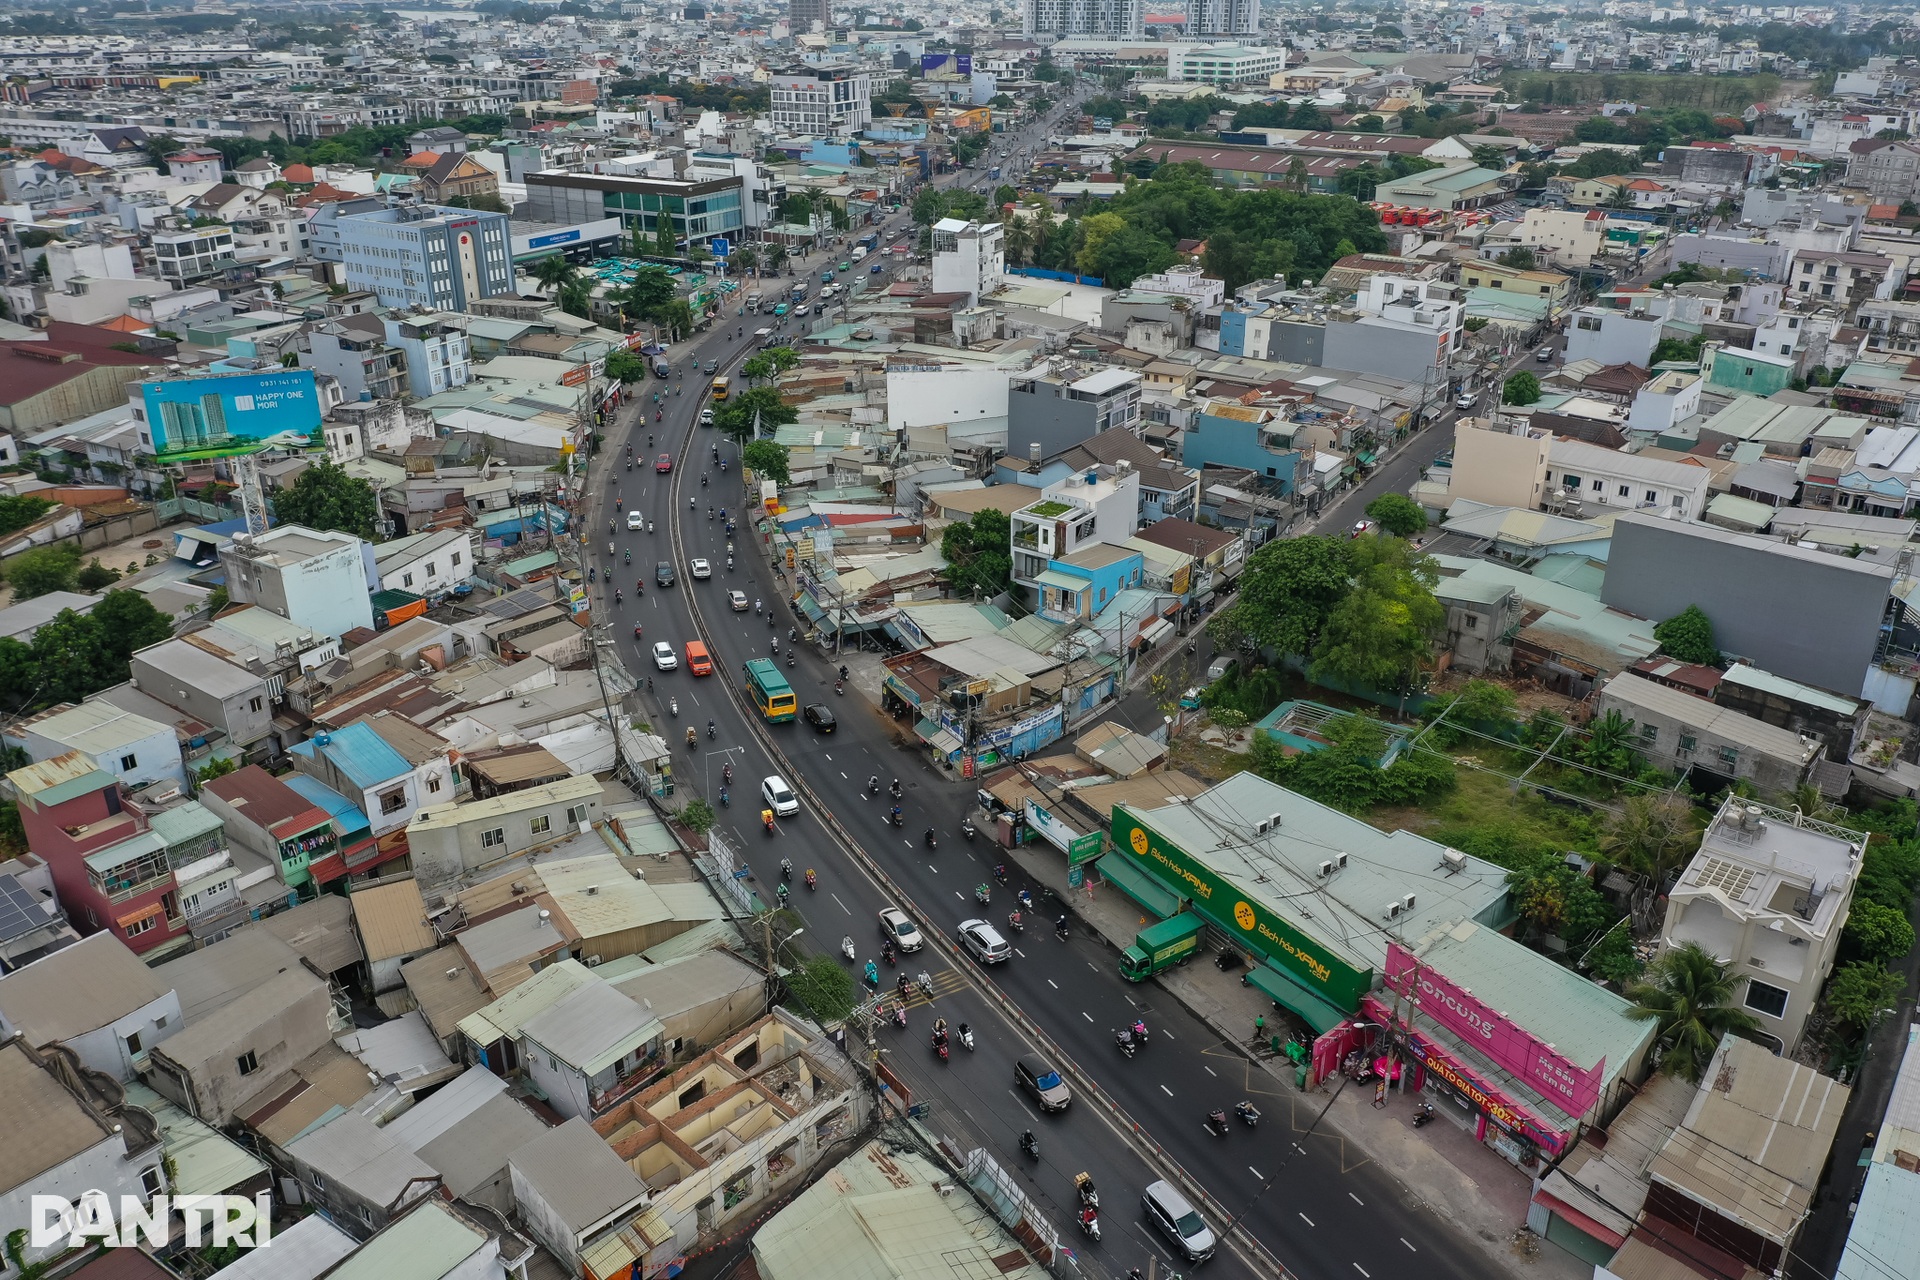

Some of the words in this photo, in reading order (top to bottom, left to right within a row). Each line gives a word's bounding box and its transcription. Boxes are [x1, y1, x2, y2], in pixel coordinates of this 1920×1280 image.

[255, 392, 284, 401] HAPPY
[286, 390, 304, 399] ONE
[257, 401, 278, 409] MORI
[1151, 847, 1168, 868] Bách
[1168, 859, 1182, 875] hóa
[1182, 869, 1212, 896] XANH
[1258, 923, 1278, 943] Bách
[1278, 937, 1295, 954] hóa
[1295, 948, 1330, 978] XANH
[1539, 1056, 1553, 1073] Mẹ
[1555, 1066, 1575, 1085] Bầu
[1543, 1072, 1558, 1088] Em
[1560, 1083, 1573, 1098] Bé
[1444, 1068, 1456, 1082] TO
[1470, 1088, 1488, 1105] TỐT
